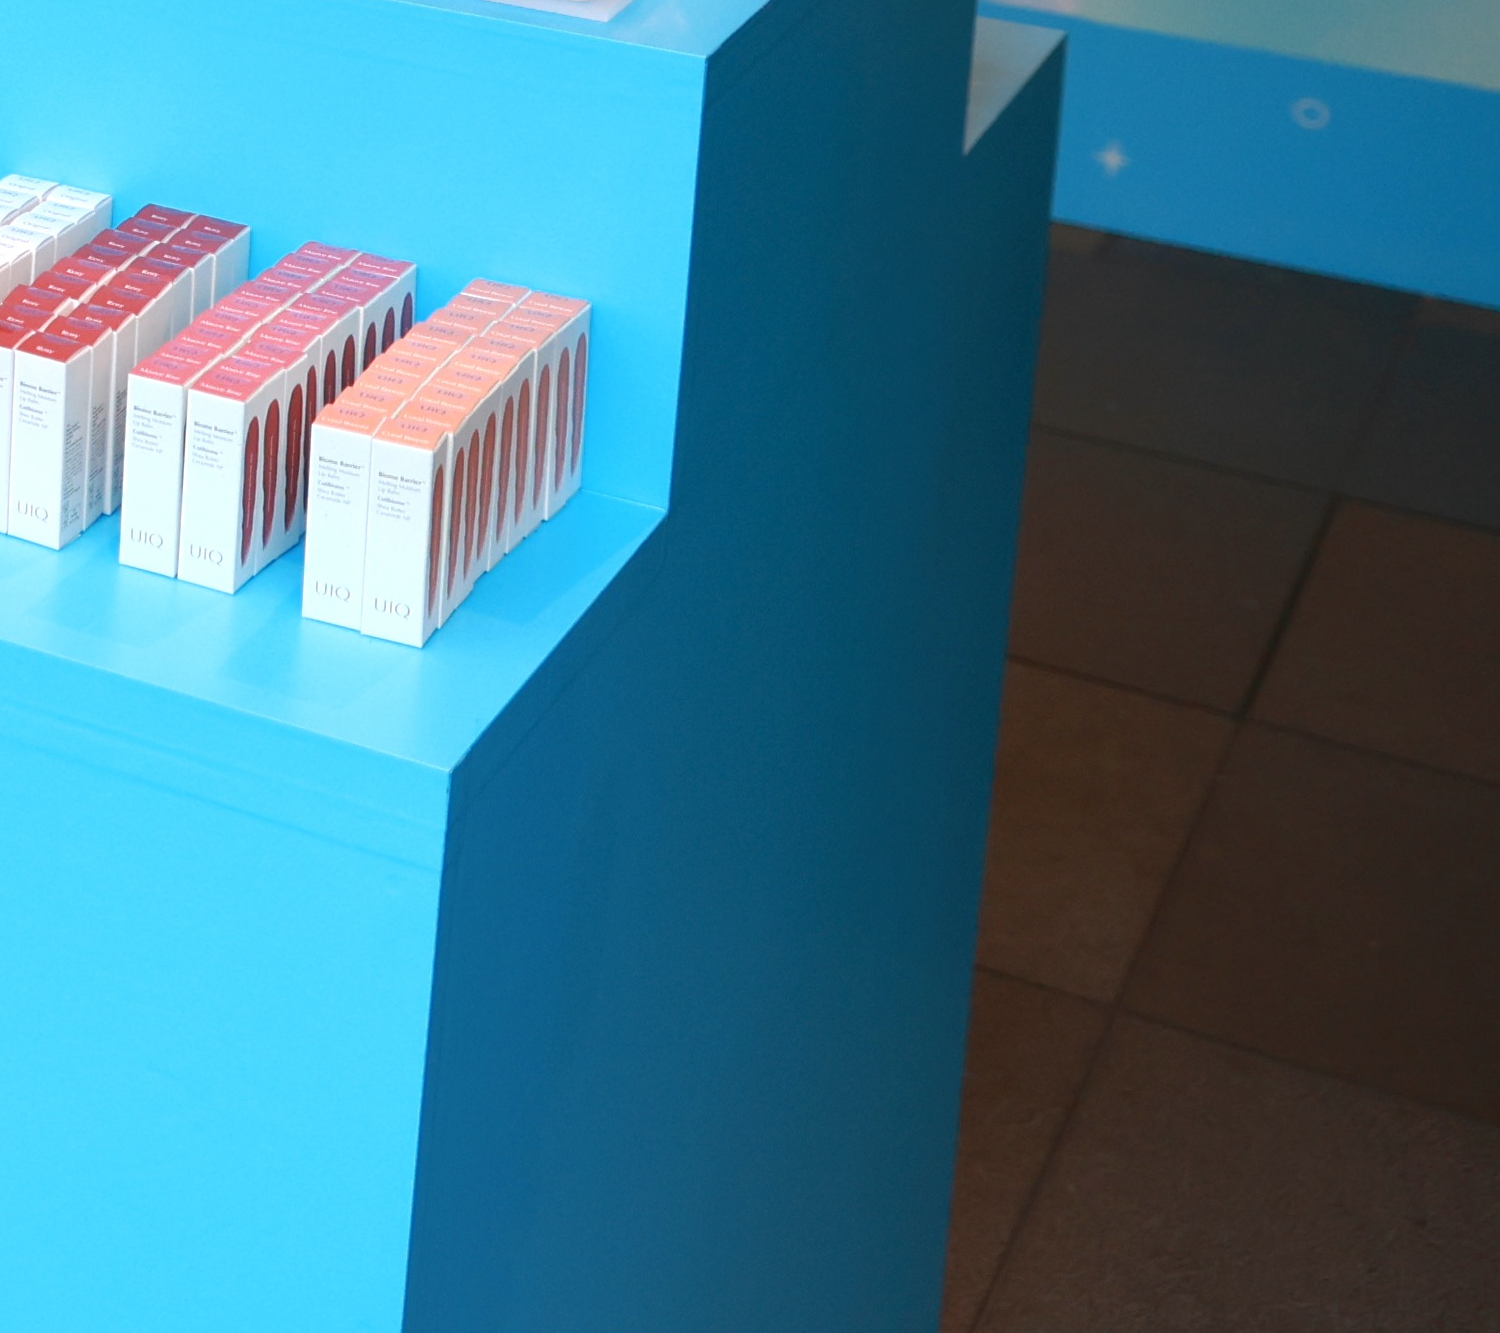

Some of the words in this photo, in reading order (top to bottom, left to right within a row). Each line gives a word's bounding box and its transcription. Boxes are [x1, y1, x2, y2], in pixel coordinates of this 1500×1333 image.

[17, 500, 49, 522] UIQ
[130, 526, 164, 549] UIQ
[190, 543, 224, 565] UIQ
[315, 580, 352, 604] UIQ
[374, 596, 411, 620] UIQ
